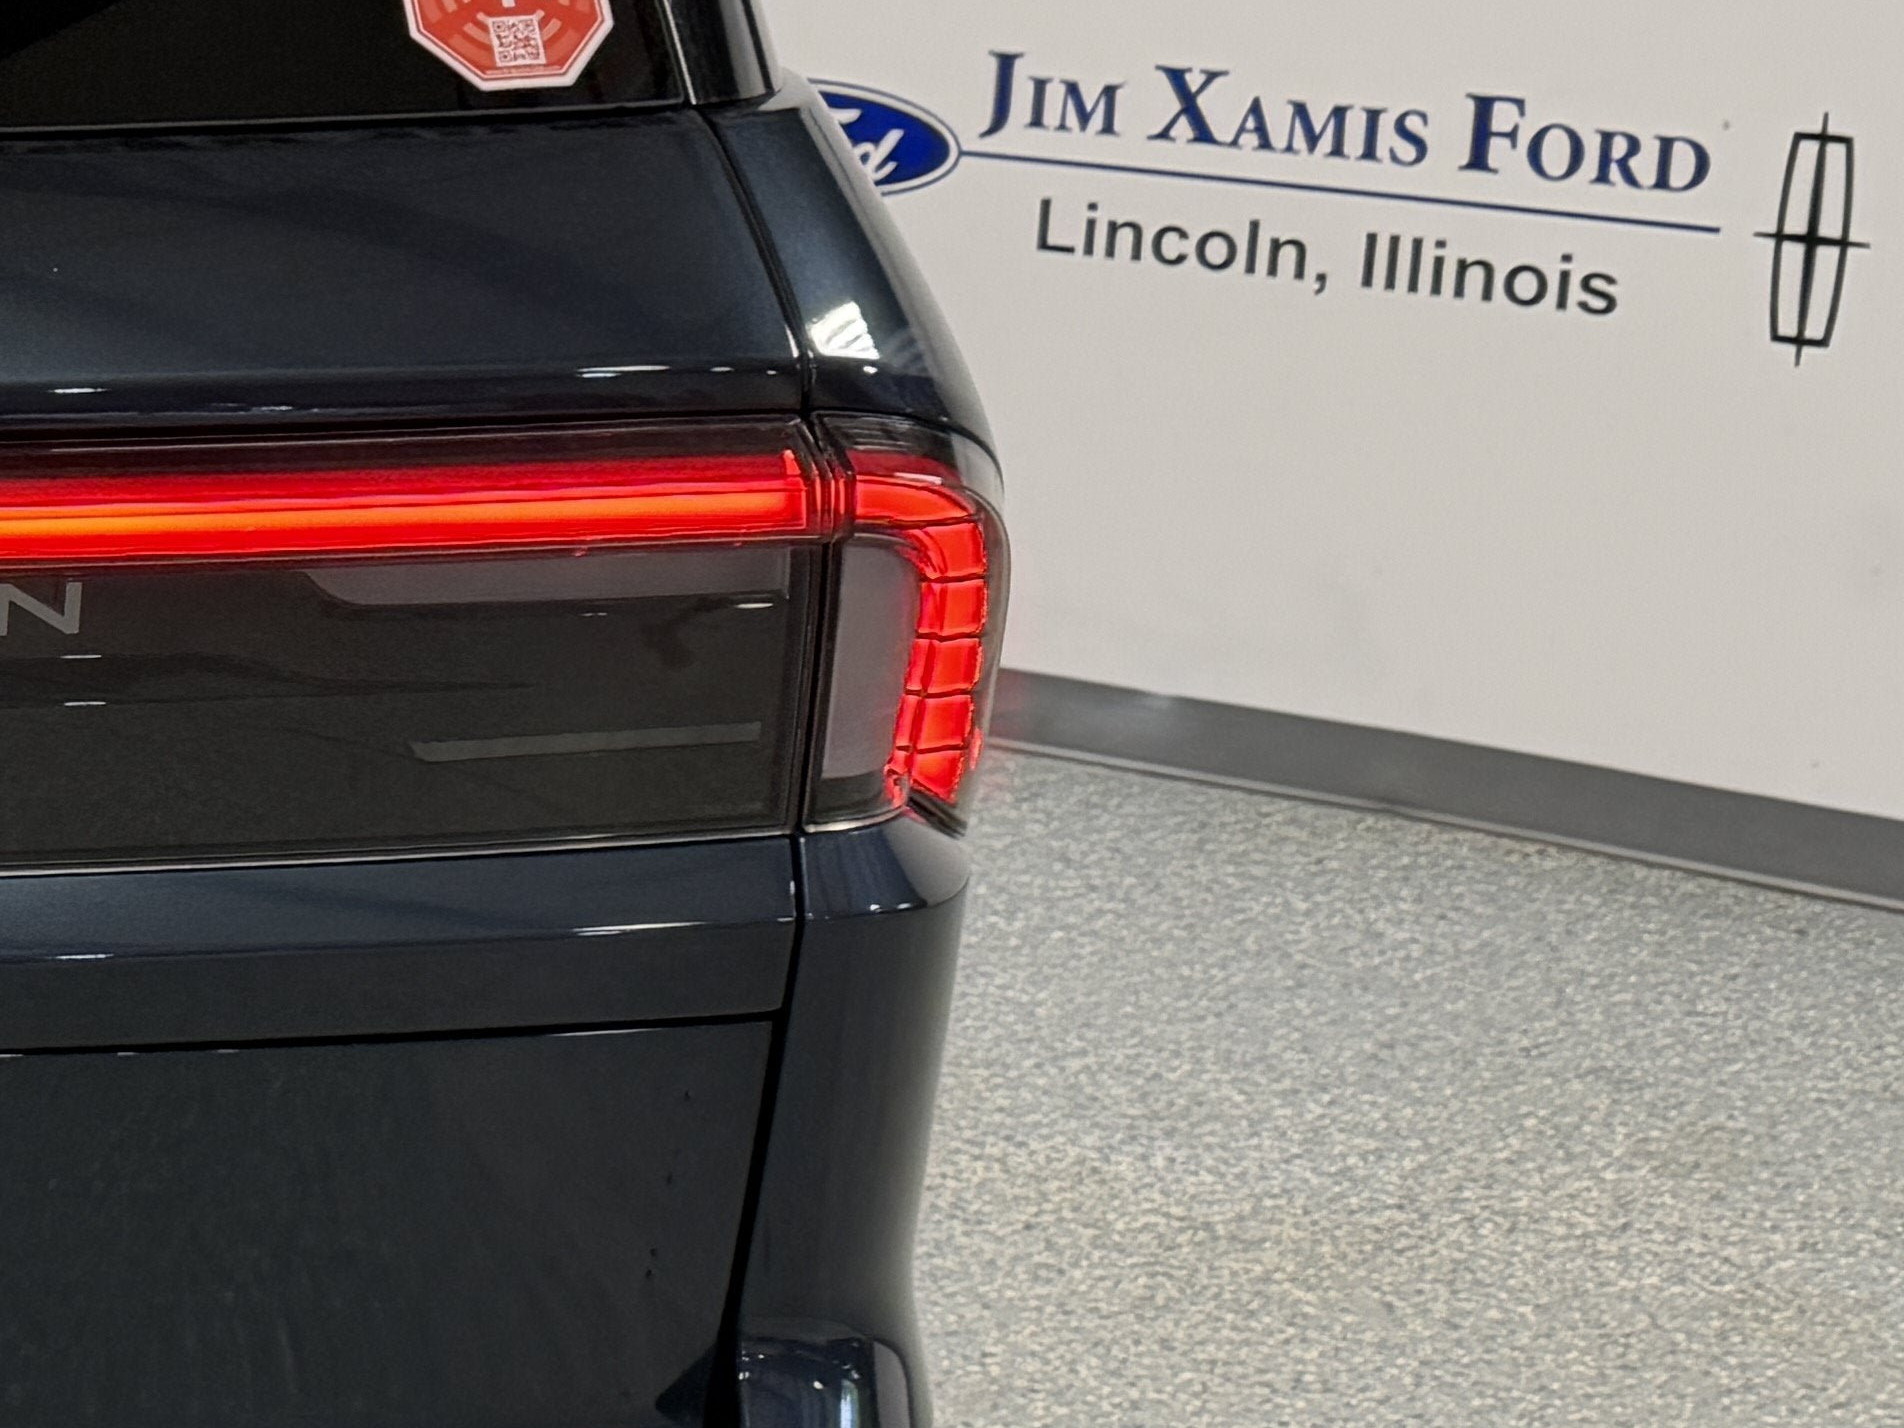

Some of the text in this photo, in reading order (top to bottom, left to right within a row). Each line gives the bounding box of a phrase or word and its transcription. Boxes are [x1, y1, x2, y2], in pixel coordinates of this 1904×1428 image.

[979, 51, 1712, 193] JIM XAMIS FORD
[1036, 197, 1619, 316] Lincoln, Illinois
